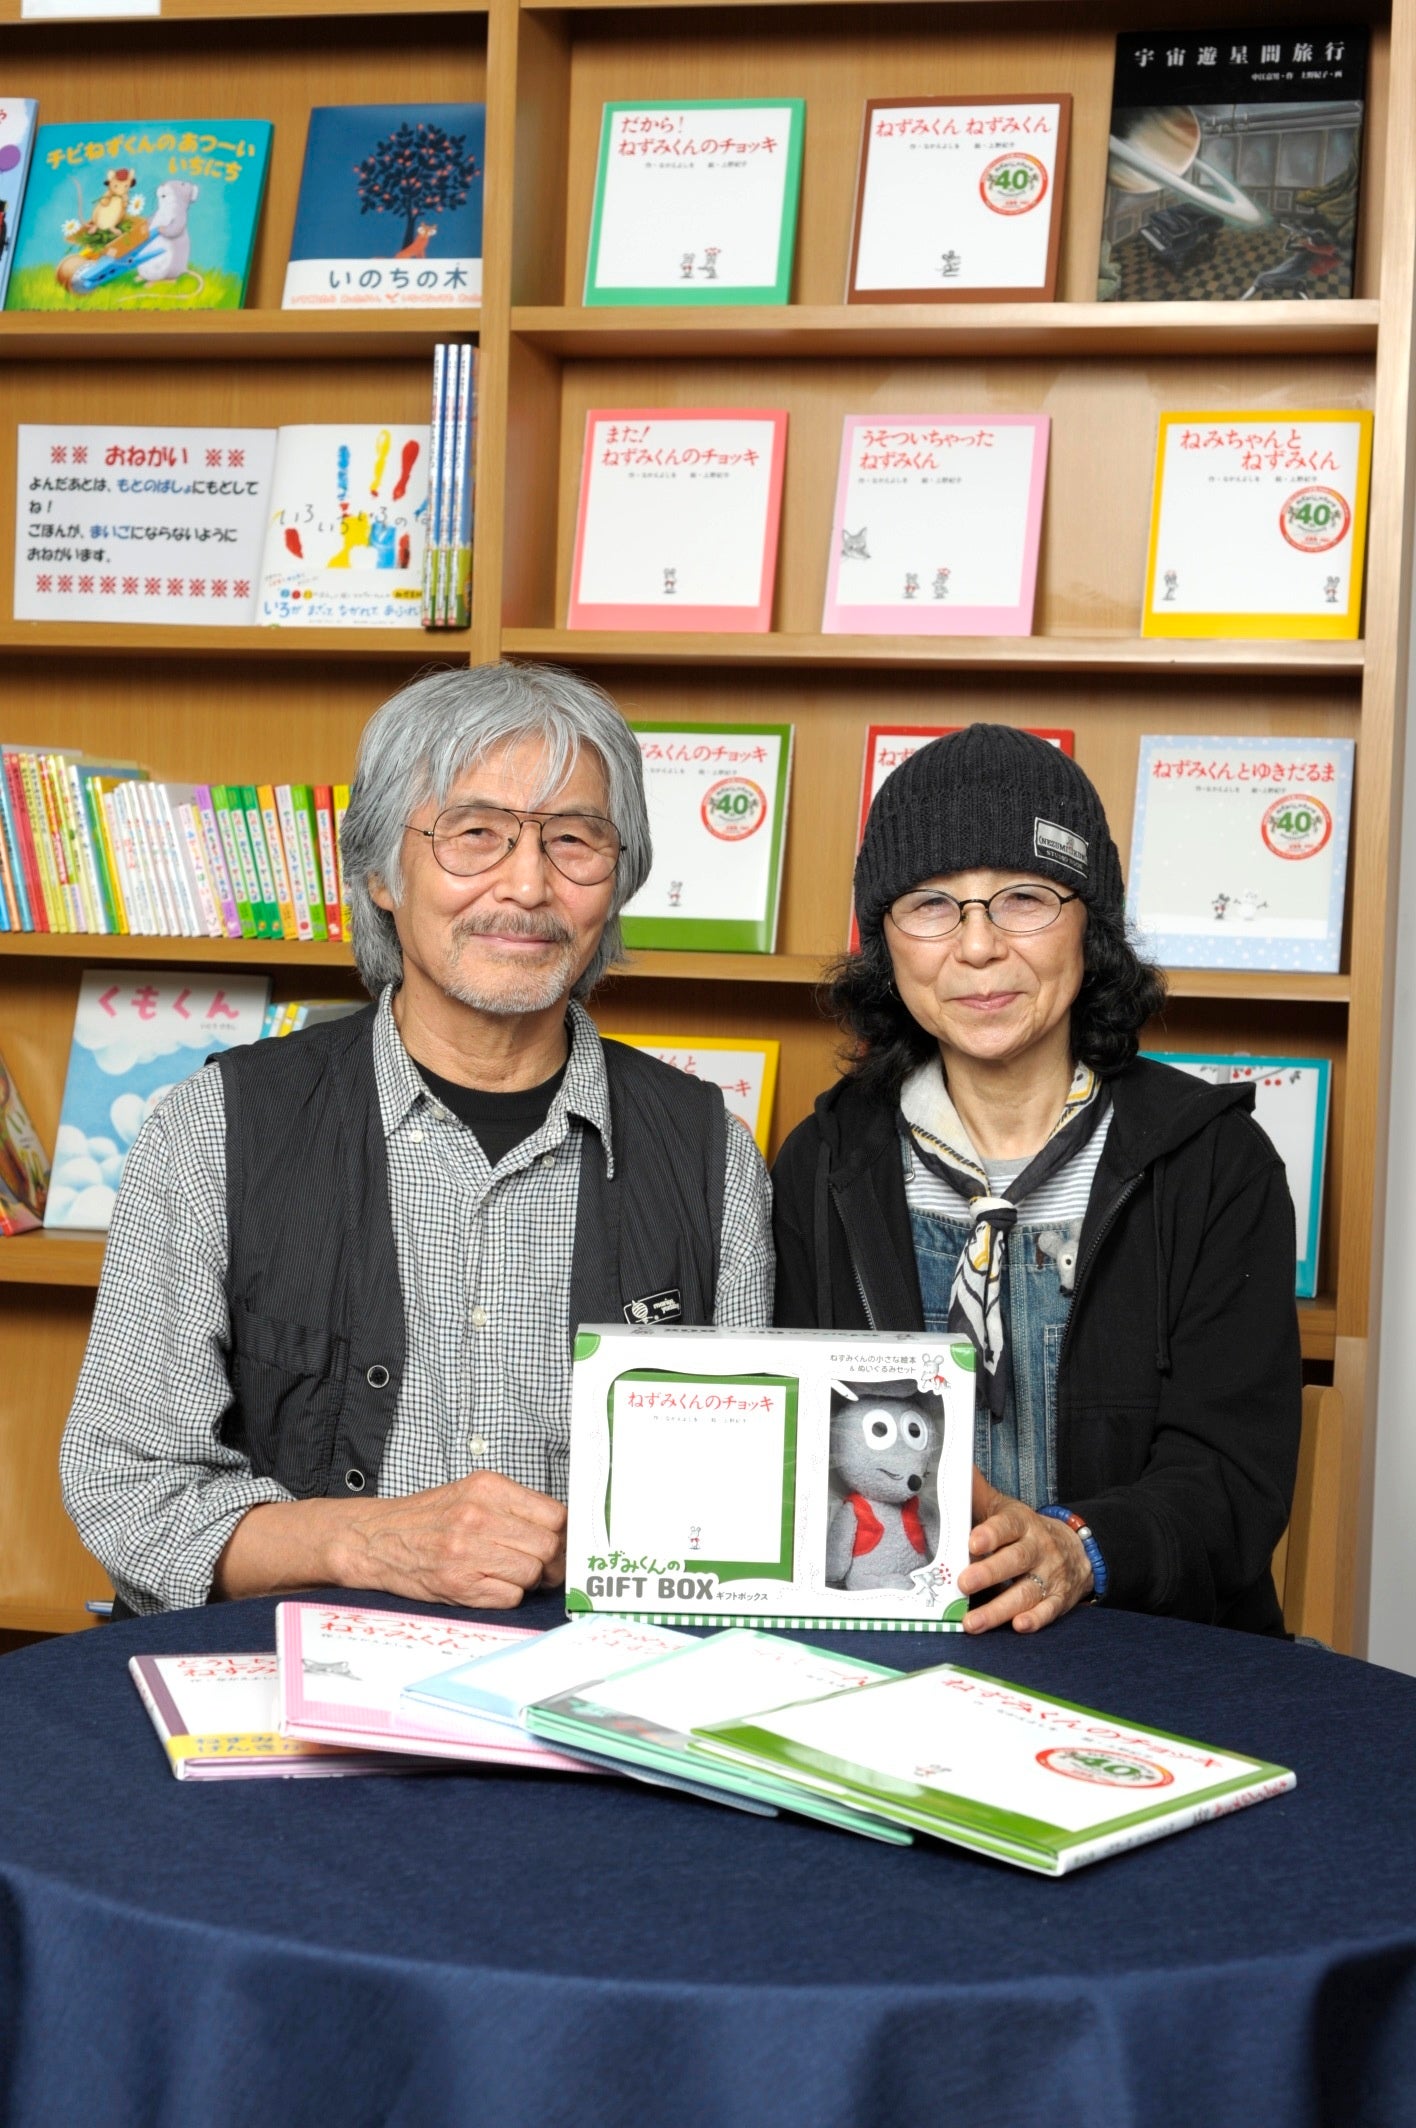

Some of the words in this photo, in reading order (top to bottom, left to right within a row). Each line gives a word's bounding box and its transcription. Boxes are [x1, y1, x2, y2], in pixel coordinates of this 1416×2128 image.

[1135, 41, 1345, 67] 宇宙遊星間旅行
[621, 116, 684, 134] だから!
[875, 118, 959, 137] ねずみくん
[965, 115, 1051, 136] ねずみくん
[46, 131, 256, 169] チビねずくんのあつーい
[618, 137, 778, 156] ねずみくんのチョッキ
[168, 157, 242, 182] いちにち
[995, 169, 1030, 190] 40
[329, 266, 469, 289] いのちの木
[606, 425, 650, 444] また!
[862, 429, 994, 447] うそついちゃった
[1180, 429, 1302, 450] ねみちゃんと
[105, 445, 189, 467] おねがい
[602, 448, 760, 466] ねずみくんのチョッキ
[860, 452, 939, 469] ねずみくん
[1241, 450, 1341, 471] ねずみくん
[1294, 503, 1331, 526] 40
[641, 743, 768, 763] みくんのチョッキ
[1152, 759, 1337, 783] ねずみくんとゆきだるま
[715, 794, 749, 814] 40
[1277, 811, 1312, 833] 40
[98, 985, 240, 1021] くもくん
[830, 1354, 917, 1364] ねずみくんの小さな絵本
[857, 1365, 917, 1374] ぬいぐるみセット
[627, 1391, 774, 1413] ねずみくんのチョッキ
[588, 1551, 680, 1575] ねずみくんの
[586, 1576, 648, 1598] GIFT
[658, 1577, 714, 1600] BOX
[716, 1591, 769, 1601] ギフトボックス
[320, 1621, 470, 1650] ねずみくん
[941, 1678, 1224, 1769] ねずみくんのチョッキ
[1074, 1757, 1142, 1777] 40
